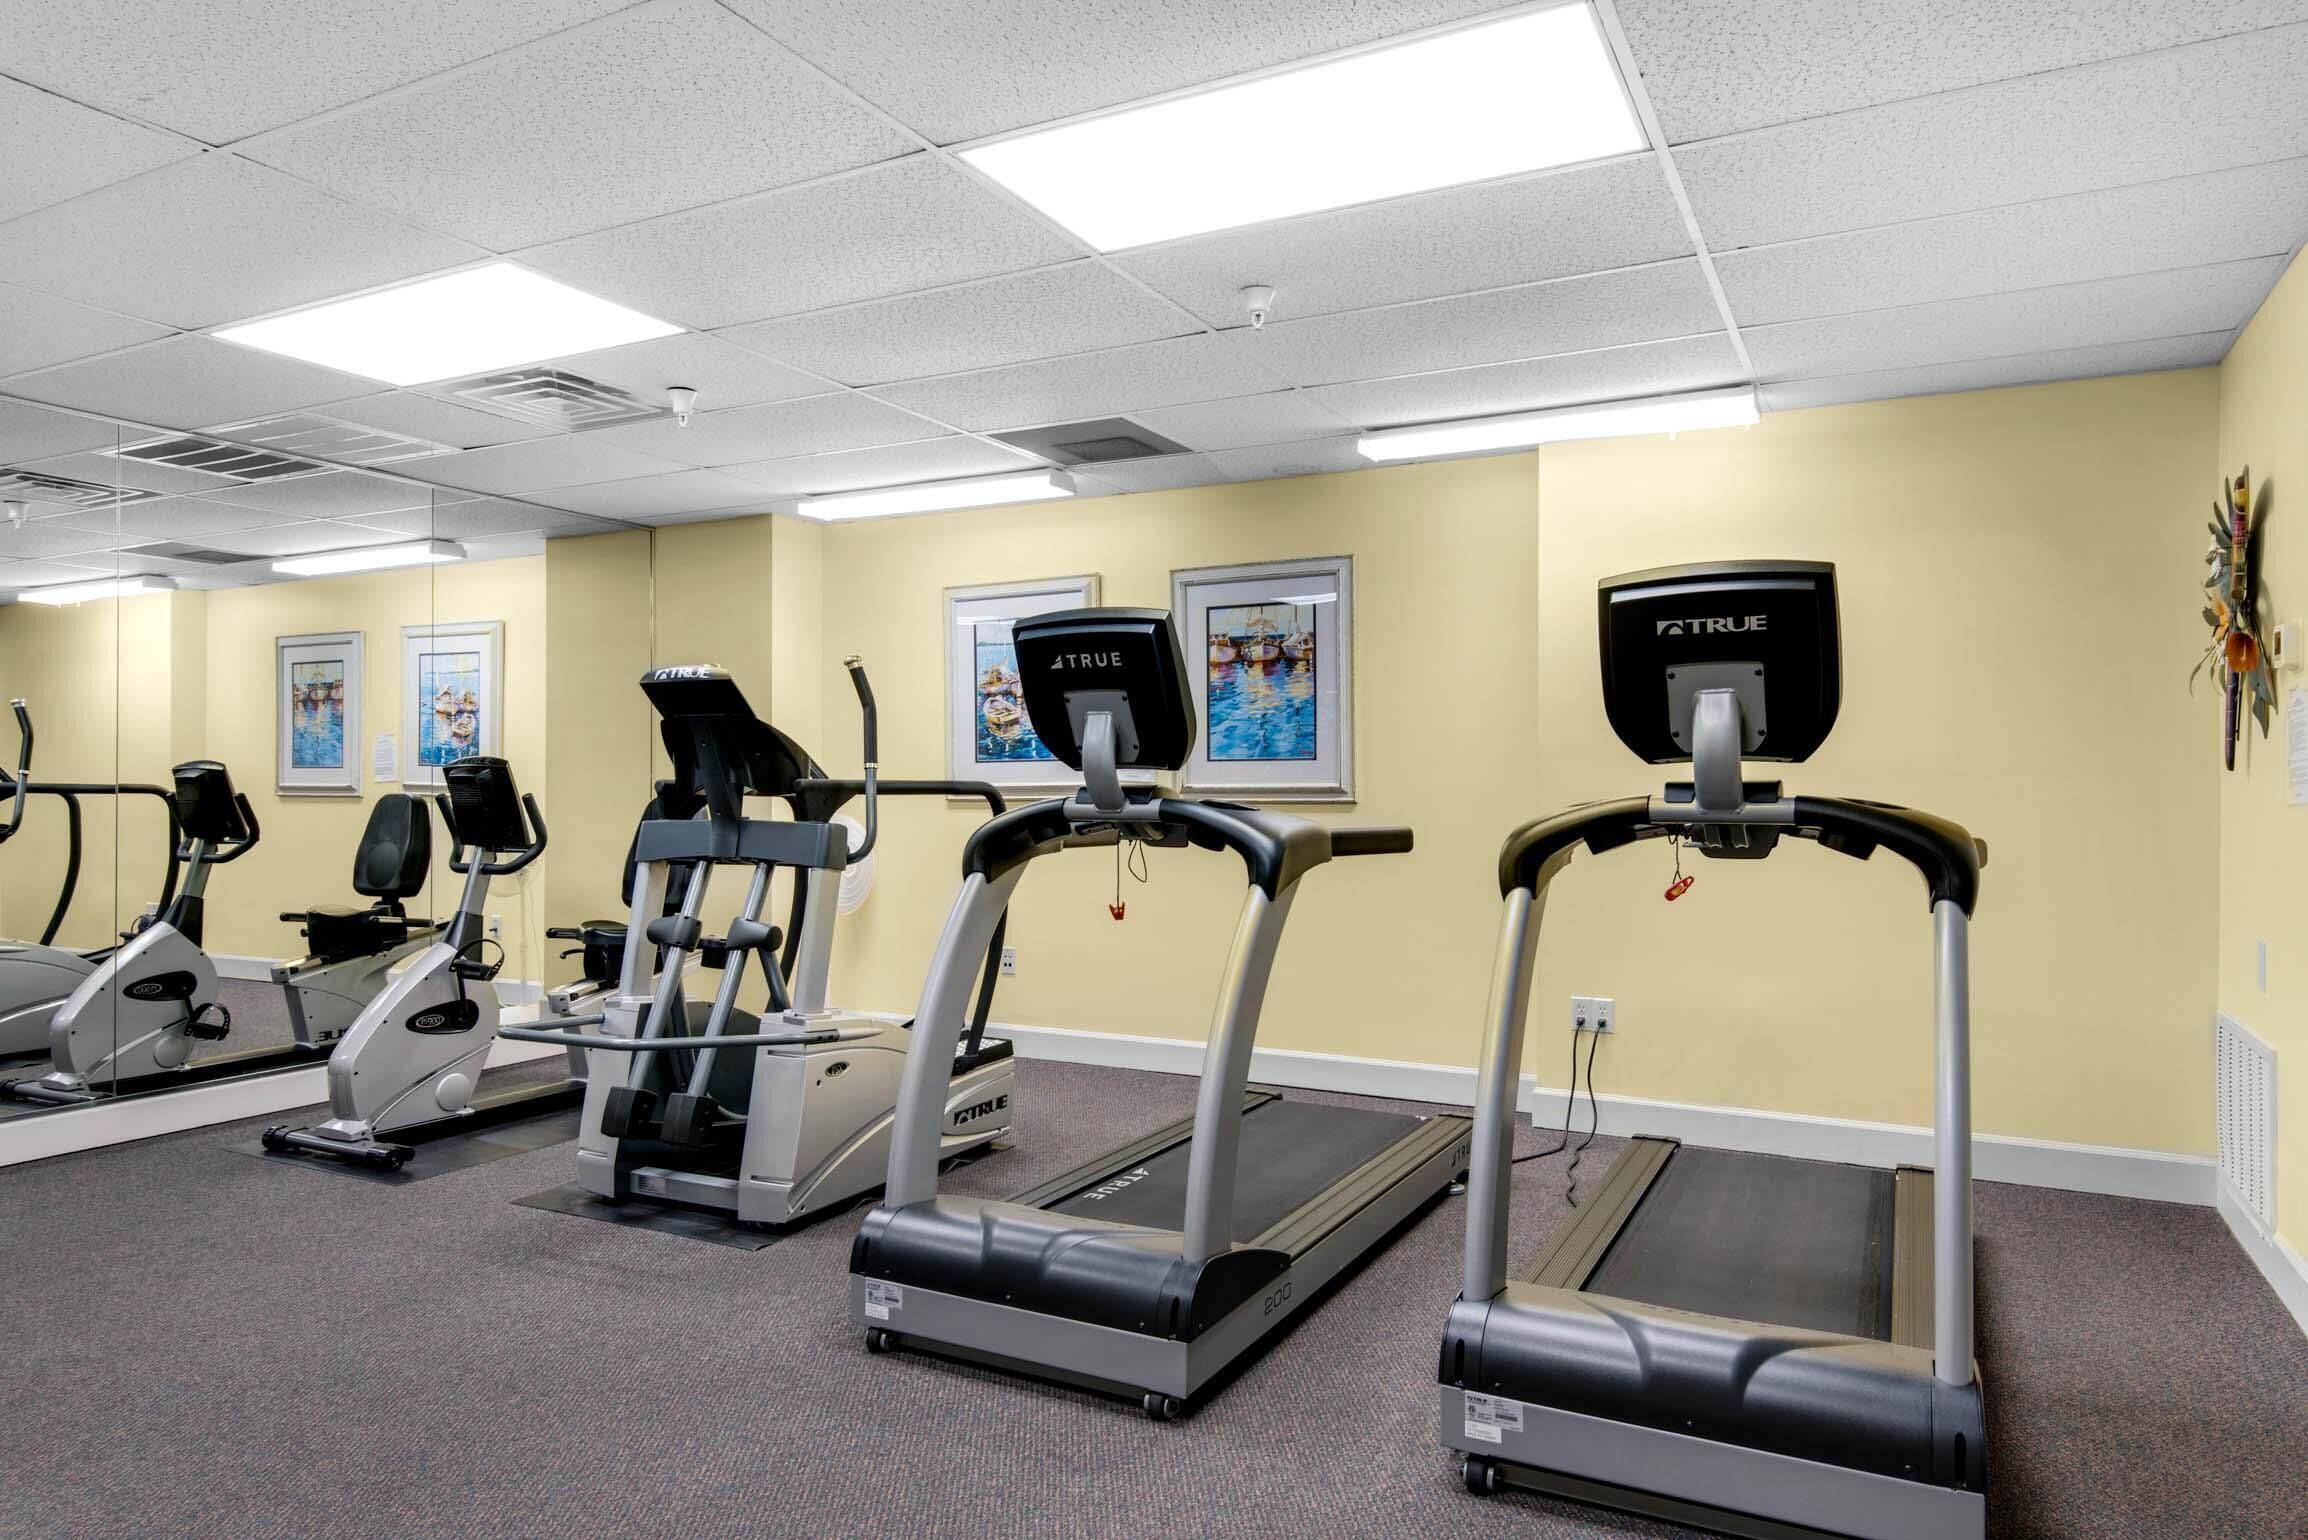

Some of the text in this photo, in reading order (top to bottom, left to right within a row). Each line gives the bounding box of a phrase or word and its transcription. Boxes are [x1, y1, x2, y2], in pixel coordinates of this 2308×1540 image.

[1685, 615, 1767, 634] TRUE
[1066, 652, 1122, 669] TRUE
[670, 667, 710, 679] TRUE
[969, 1095, 1008, 1119] TRUE
[1083, 1176, 1143, 1200] TRUE
[1264, 1282, 1291, 1316] 200
